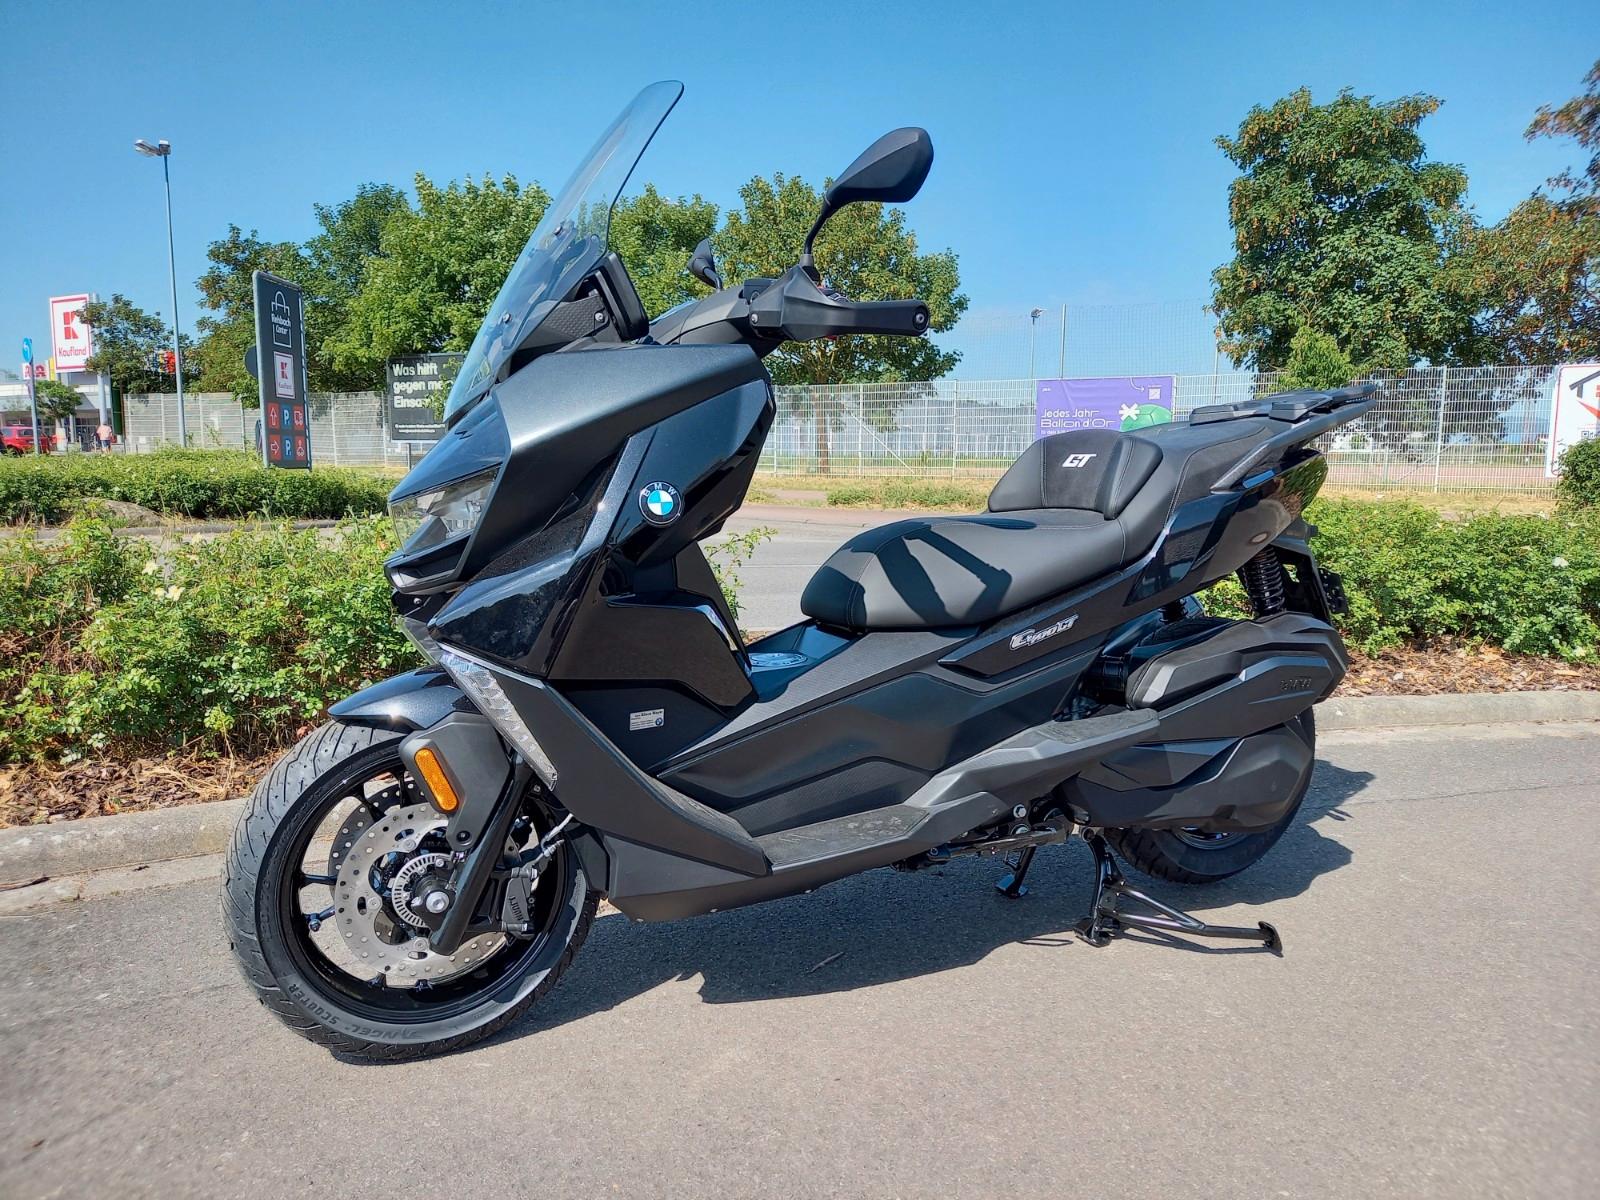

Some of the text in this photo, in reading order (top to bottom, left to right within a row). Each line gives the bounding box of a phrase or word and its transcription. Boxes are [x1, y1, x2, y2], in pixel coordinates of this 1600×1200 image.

[58, 346, 87, 357] Kaufland
[392, 362, 438, 376] Was hilft
[393, 381, 426, 394] gegen
[1041, 409, 1100, 418] Jedes Jahr
[1040, 419, 1081, 428] Ballon
[1062, 453, 1097, 468] GT
[643, 482, 677, 497] BMW
[288, 983, 425, 1039] ANGEL SCOOTER
